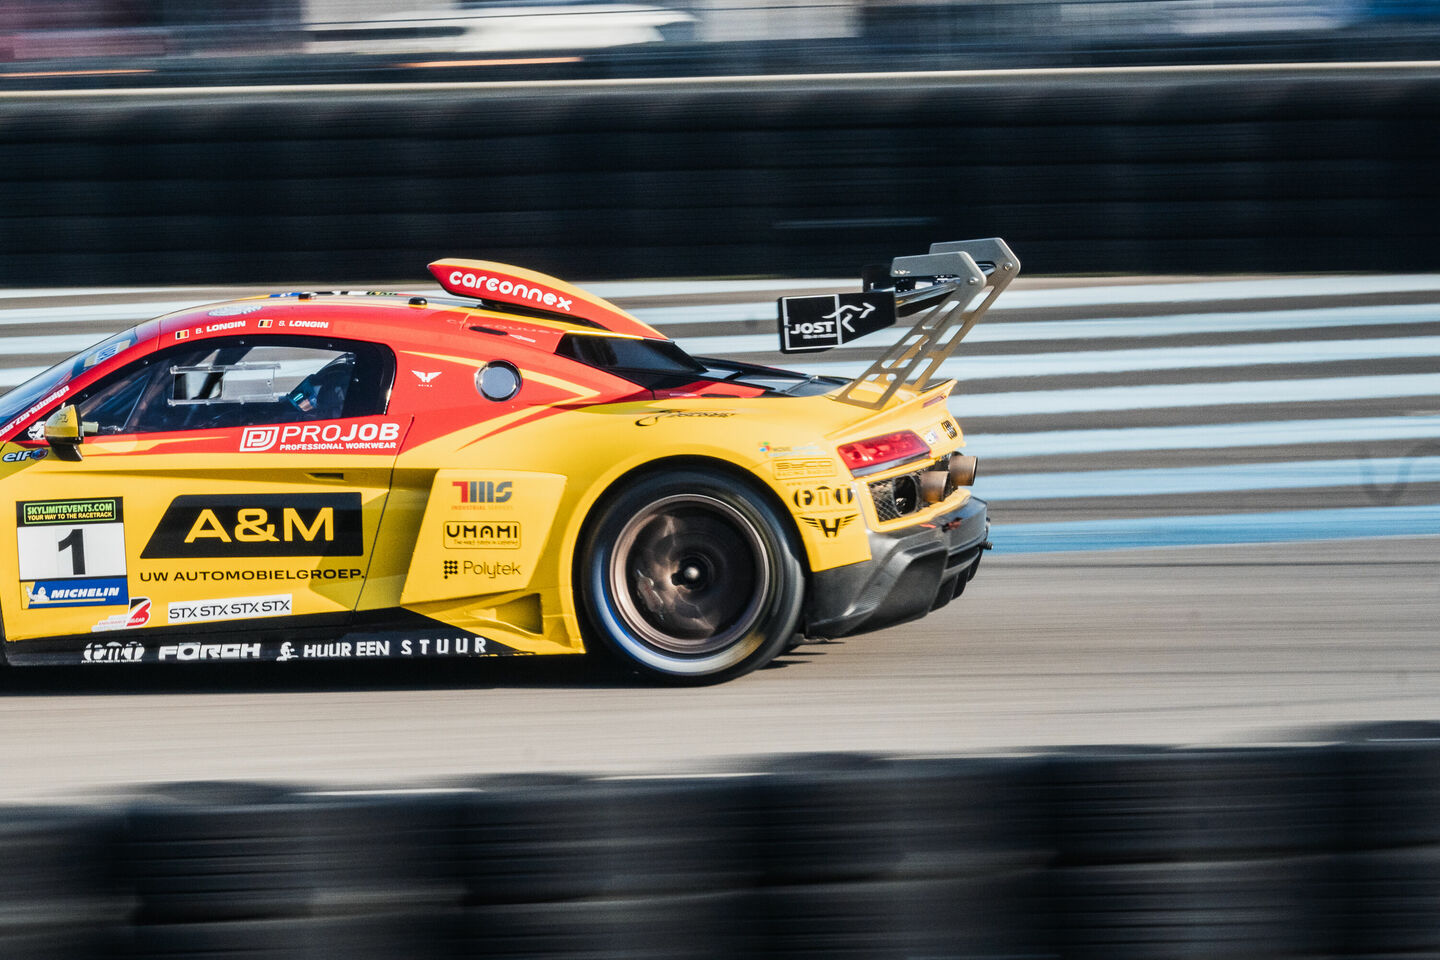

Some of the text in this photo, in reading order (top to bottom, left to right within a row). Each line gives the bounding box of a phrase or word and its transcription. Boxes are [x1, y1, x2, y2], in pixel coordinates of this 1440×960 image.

[449, 271, 573, 312] carconnex
[206, 320, 246, 333] LONGIN
[288, 320, 329, 329] LONGIN
[790, 321, 835, 335] JOST
[280, 423, 400, 443] PROJOB
[279, 441, 397, 451] PROFESSIONAL WORKWEAR
[3, 450, 31, 462] elf
[27, 503, 112, 515] SKYLIMITEVENTS.COM
[183, 507, 334, 543] A&M
[446, 525, 518, 538] UMAMI
[58, 528, 86, 576] 1
[140, 568, 365, 582] UW AUTOMOBIELGROEP.
[463, 560, 522, 579] Polytek
[51, 587, 120, 599] MICHELIN
[169, 599, 290, 619] STX STX STX STX
[303, 637, 487, 658] HUUR EEN STUUR
